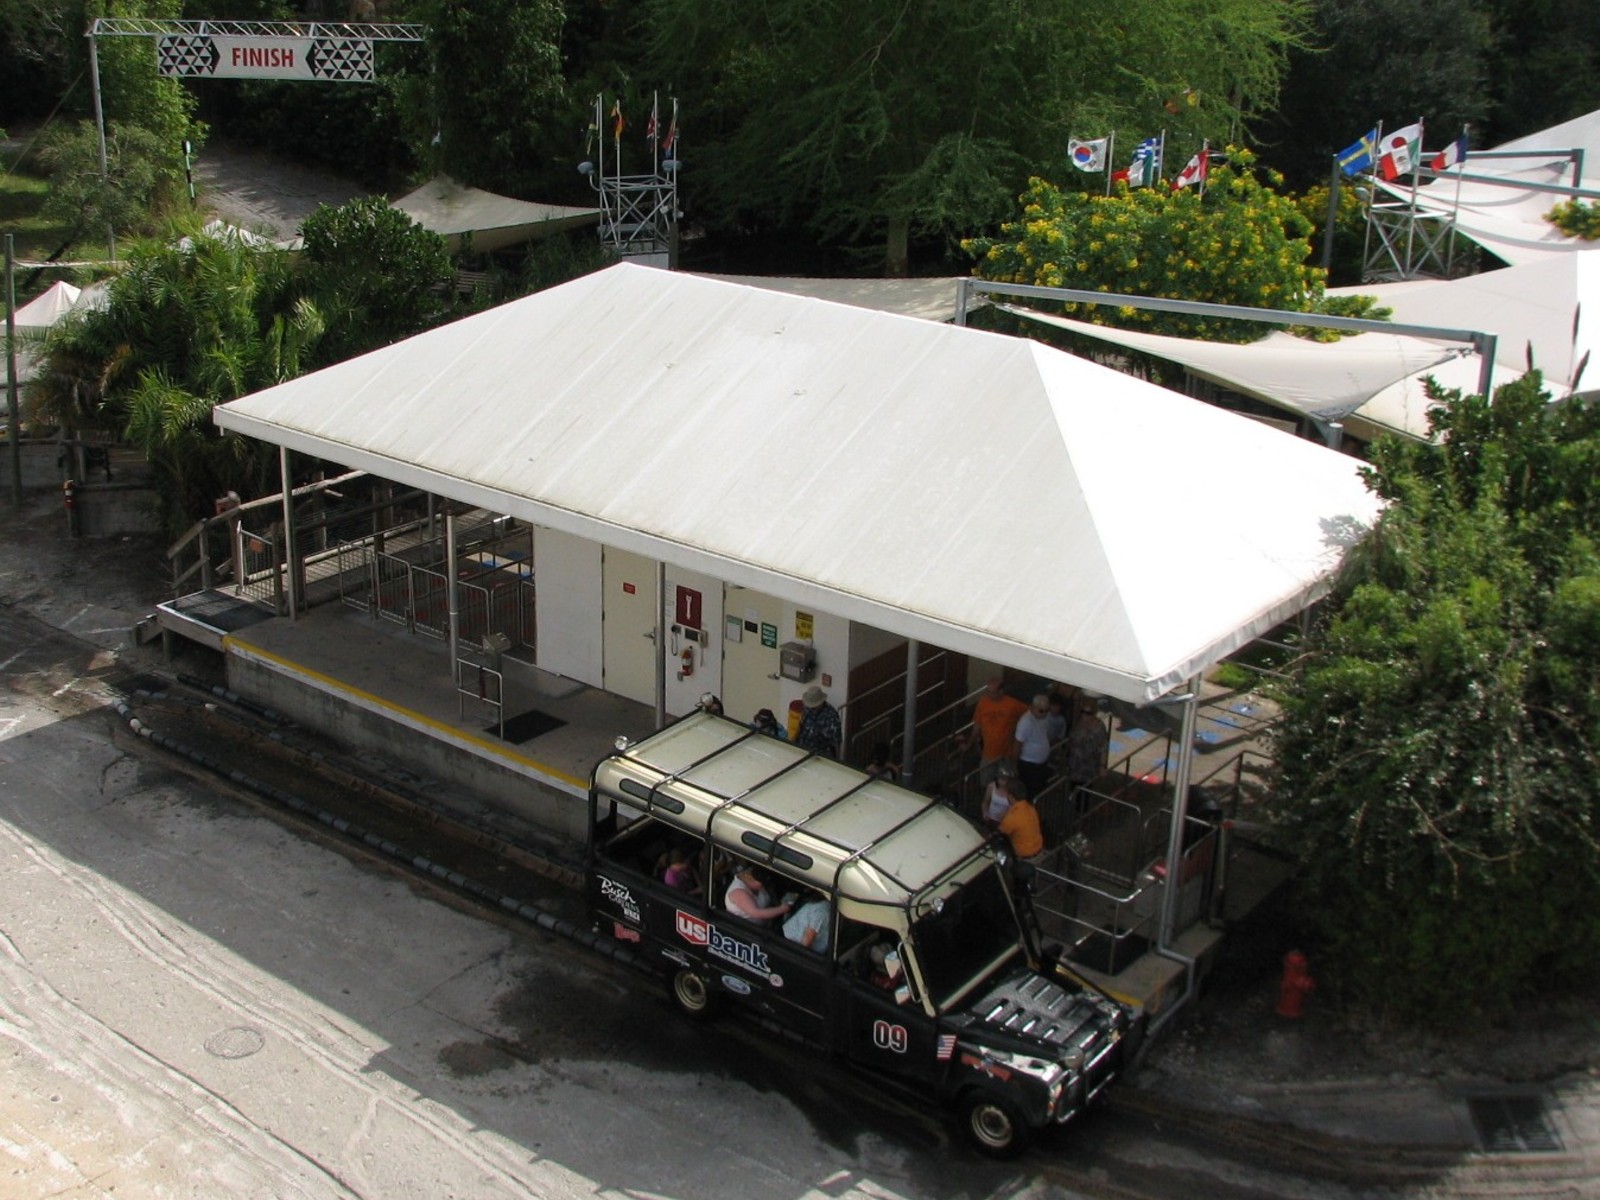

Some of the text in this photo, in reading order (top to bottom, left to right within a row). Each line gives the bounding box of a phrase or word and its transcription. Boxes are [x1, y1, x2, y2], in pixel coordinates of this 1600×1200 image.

[232, 48, 294, 68] FINISH
[597, 875, 637, 904] Busch
[708, 923, 771, 974] bank
[873, 1019, 908, 1054] 09
